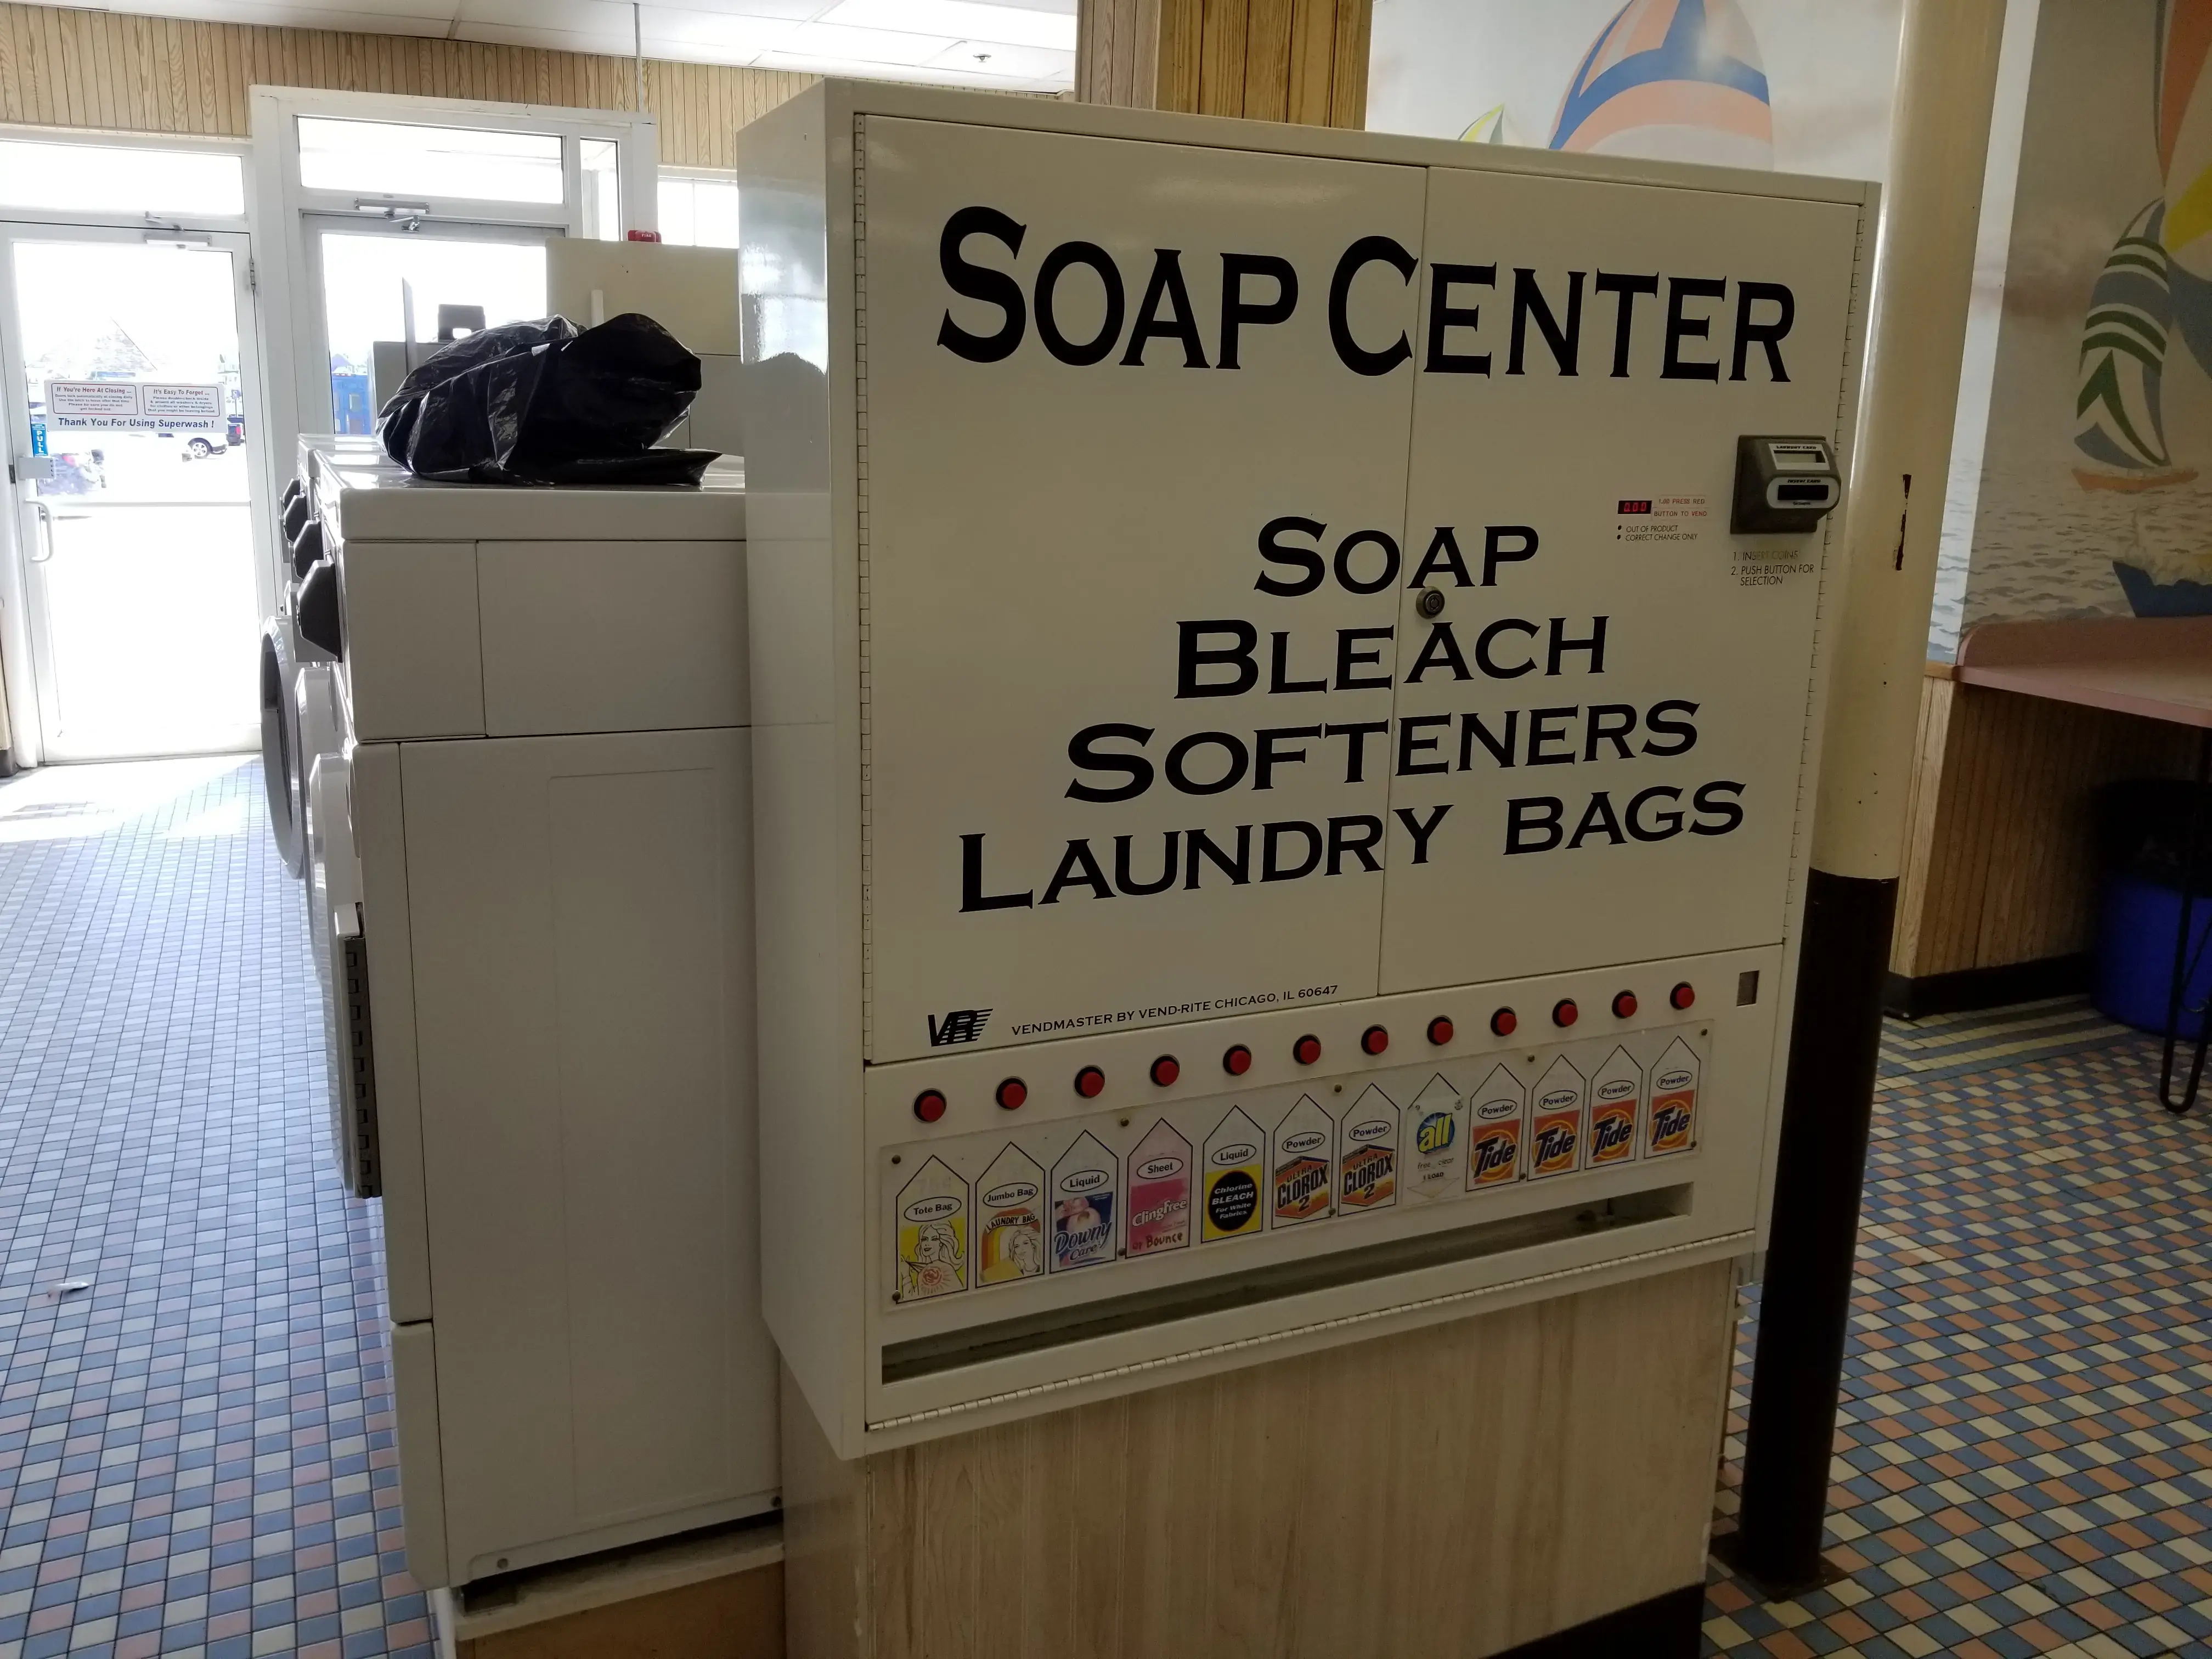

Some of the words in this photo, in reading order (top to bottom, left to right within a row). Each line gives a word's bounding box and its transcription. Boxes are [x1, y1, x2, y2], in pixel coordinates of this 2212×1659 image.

[937, 206, 1298, 370] SOAP
[1329, 236, 1795, 385] CENTER
[58, 417, 87, 426] Thank
[90, 418, 108, 427] You
[111, 419, 126, 427] For
[129, 419, 155, 428] Using
[158, 419, 208, 429] Superwash
[1253, 517, 1538, 597] SOAP
[1733, 552, 1740, 561] 1.
[1742, 551, 1769, 561] INSERT
[1772, 550, 1798, 560] COINS
[1731, 566, 1738, 575] 2.
[1741, 566, 1762, 575] PUSH
[1764, 565, 1796, 574] BUTTON
[1798, 564, 1814, 573] FOR
[1740, 576, 1783, 586] SELECTION
[1174, 616, 1610, 699] BLEACH
[1064, 700, 1701, 803] SOFTENERS
[959, 804, 1454, 913] LAUNDRY
[1503, 780, 1747, 856] BAGS
[1012, 1013, 1114, 1036] VENDMASTER
[1117, 1011, 1135, 1023] BY
[1138, 1001, 1211, 1019] VEND-RITE
[1214, 992, 1279, 1009] CHICAGO,
[1283, 991, 1295, 1001] IL
[1298, 985, 1338, 998] 60647
[1660, 1075, 1689, 1086] Powder
[1601, 1085, 1632, 1096] Powder
[1543, 1094, 1574, 1105] Powder
[1481, 1103, 1514, 1115] Powder
[1353, 1125, 1387, 1138] Powder
[1419, 1113, 1453, 1153] all
[1651, 1105, 1691, 1147] Tide
[1286, 1137, 1322, 1149] Powder
[1592, 1115, 1633, 1158] Tide
[1220, 1149, 1249, 1161] Liquid
[1534, 1126, 1576, 1168] Tide
[1353, 1153, 1378, 1170] ULTRA
[1474, 1135, 1516, 1178] Tide
[1148, 1162, 1173, 1174] Sheet
[1286, 1165, 1313, 1183] ULTRA
[1344, 1152, 1393, 1195] CLOROX
[1070, 1174, 1101, 1188] Liquid
[1214, 1183, 1253, 1194] Chlorine
[1277, 1163, 1328, 1209] CLOROX
[988, 1192, 1015, 1203] Jumbo
[1212, 1192, 1254, 1206] BLEACH
[1364, 1182, 1376, 1199] 2
[913, 1206, 933, 1216] Tote
[1229, 1202, 1252, 1211] White
[1298, 1195, 1310, 1212] 2
[986, 1216, 1019, 1232] LAUNDRY
[1022, 1212, 1036, 1223] BAG
[1220, 1210, 1248, 1219] Fabrics
[1054, 1221, 1113, 1254] Downy
[1132, 1241, 1142, 1250] or
[1146, 1232, 1183, 1248] Bounce
[1070, 1244, 1097, 1261] Care
